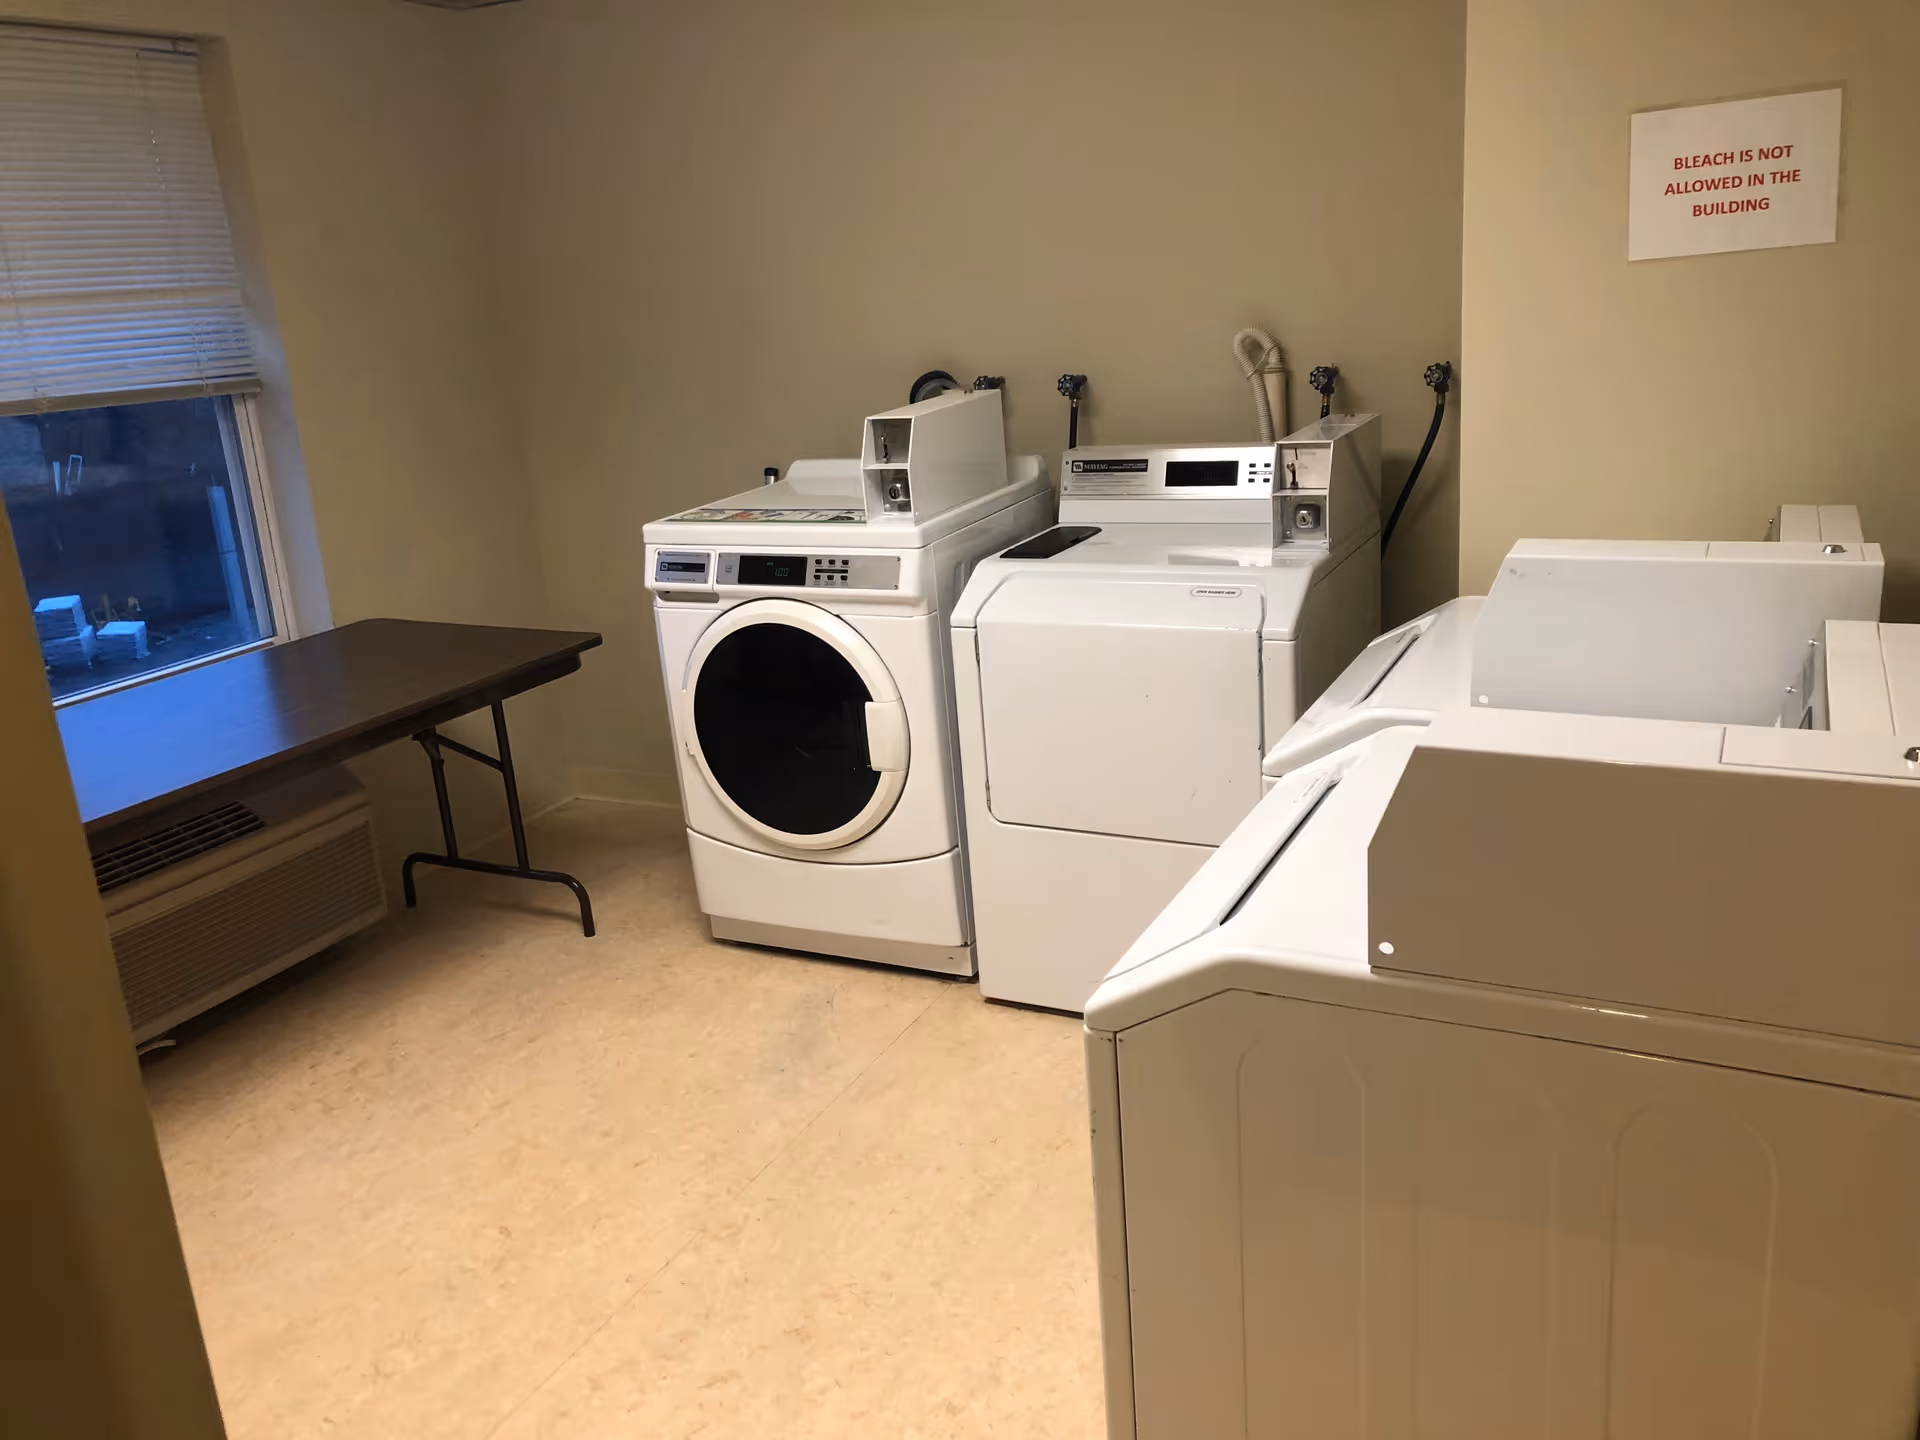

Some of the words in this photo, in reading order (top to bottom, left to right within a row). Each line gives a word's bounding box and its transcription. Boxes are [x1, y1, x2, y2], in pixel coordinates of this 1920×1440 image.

[1674, 151, 1734, 170] BLEACH
[1740, 149, 1753, 162] IS
[1758, 145, 1794, 160] NOT
[1664, 176, 1743, 196] ALLOWED
[1747, 173, 1765, 187] IN
[1769, 169, 1801, 184] THE
[1692, 198, 1770, 217] BUILDING
